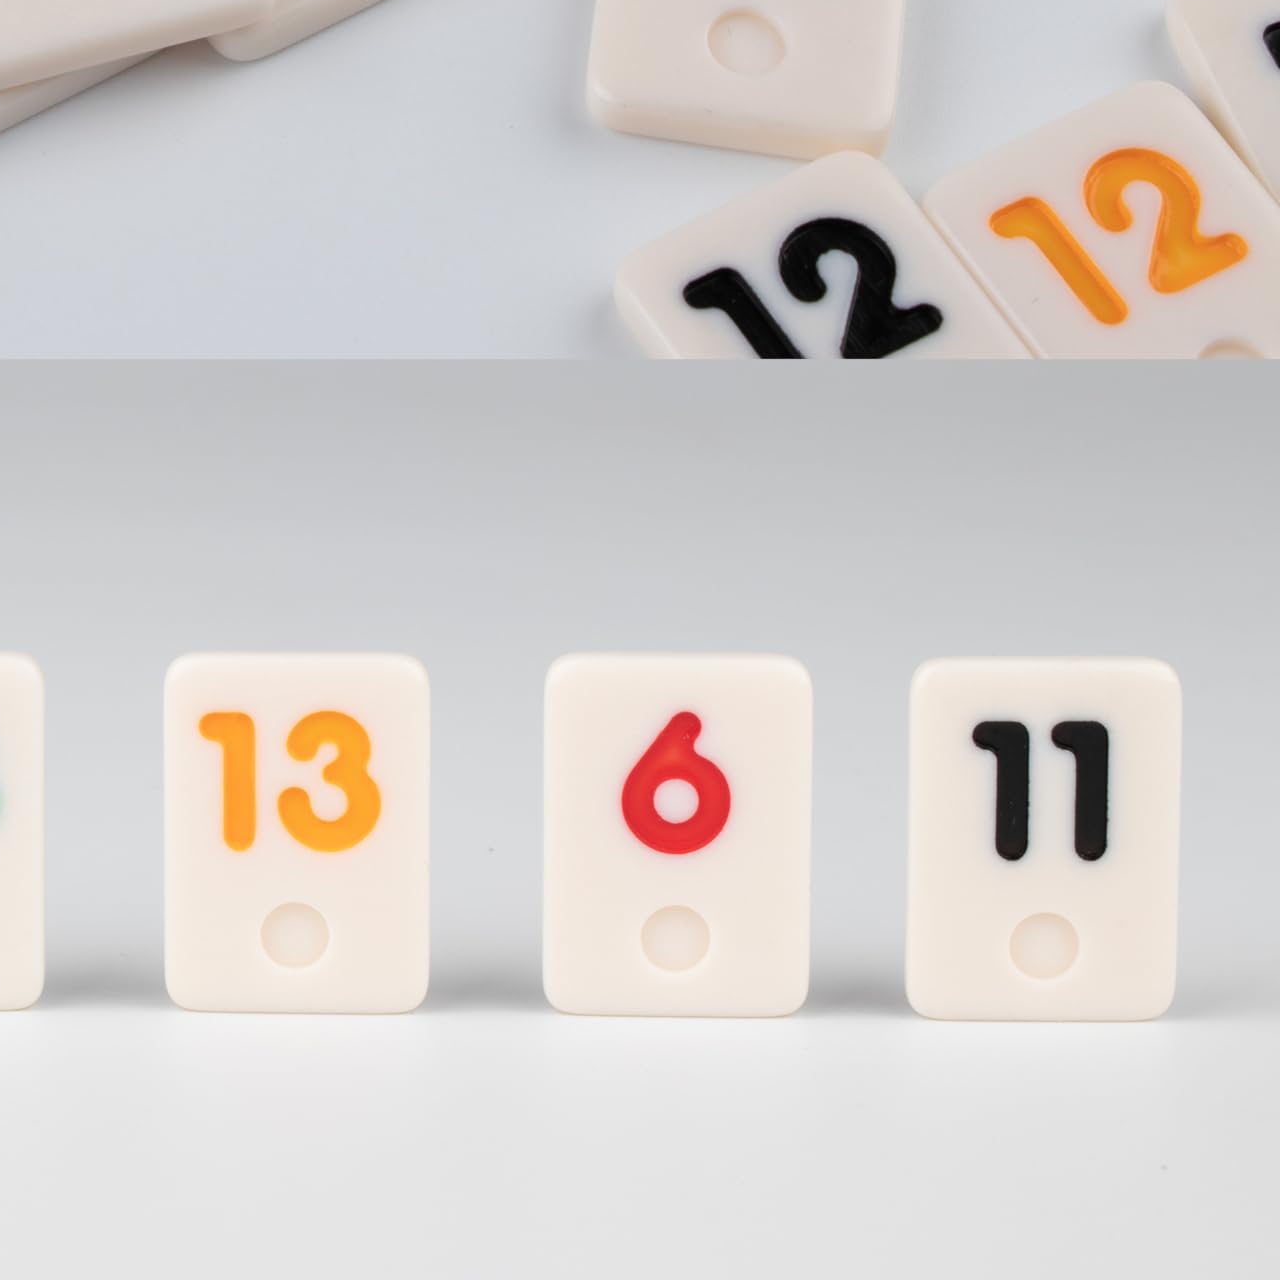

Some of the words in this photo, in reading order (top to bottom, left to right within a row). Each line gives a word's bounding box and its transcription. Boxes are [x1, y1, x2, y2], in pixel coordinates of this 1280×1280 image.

[683, 218, 943, 359] 12
[988, 147, 1249, 326] 12
[198, 710, 381, 853] 13
[621, 712, 731, 855] 6
[973, 721, 1108, 861] 11
